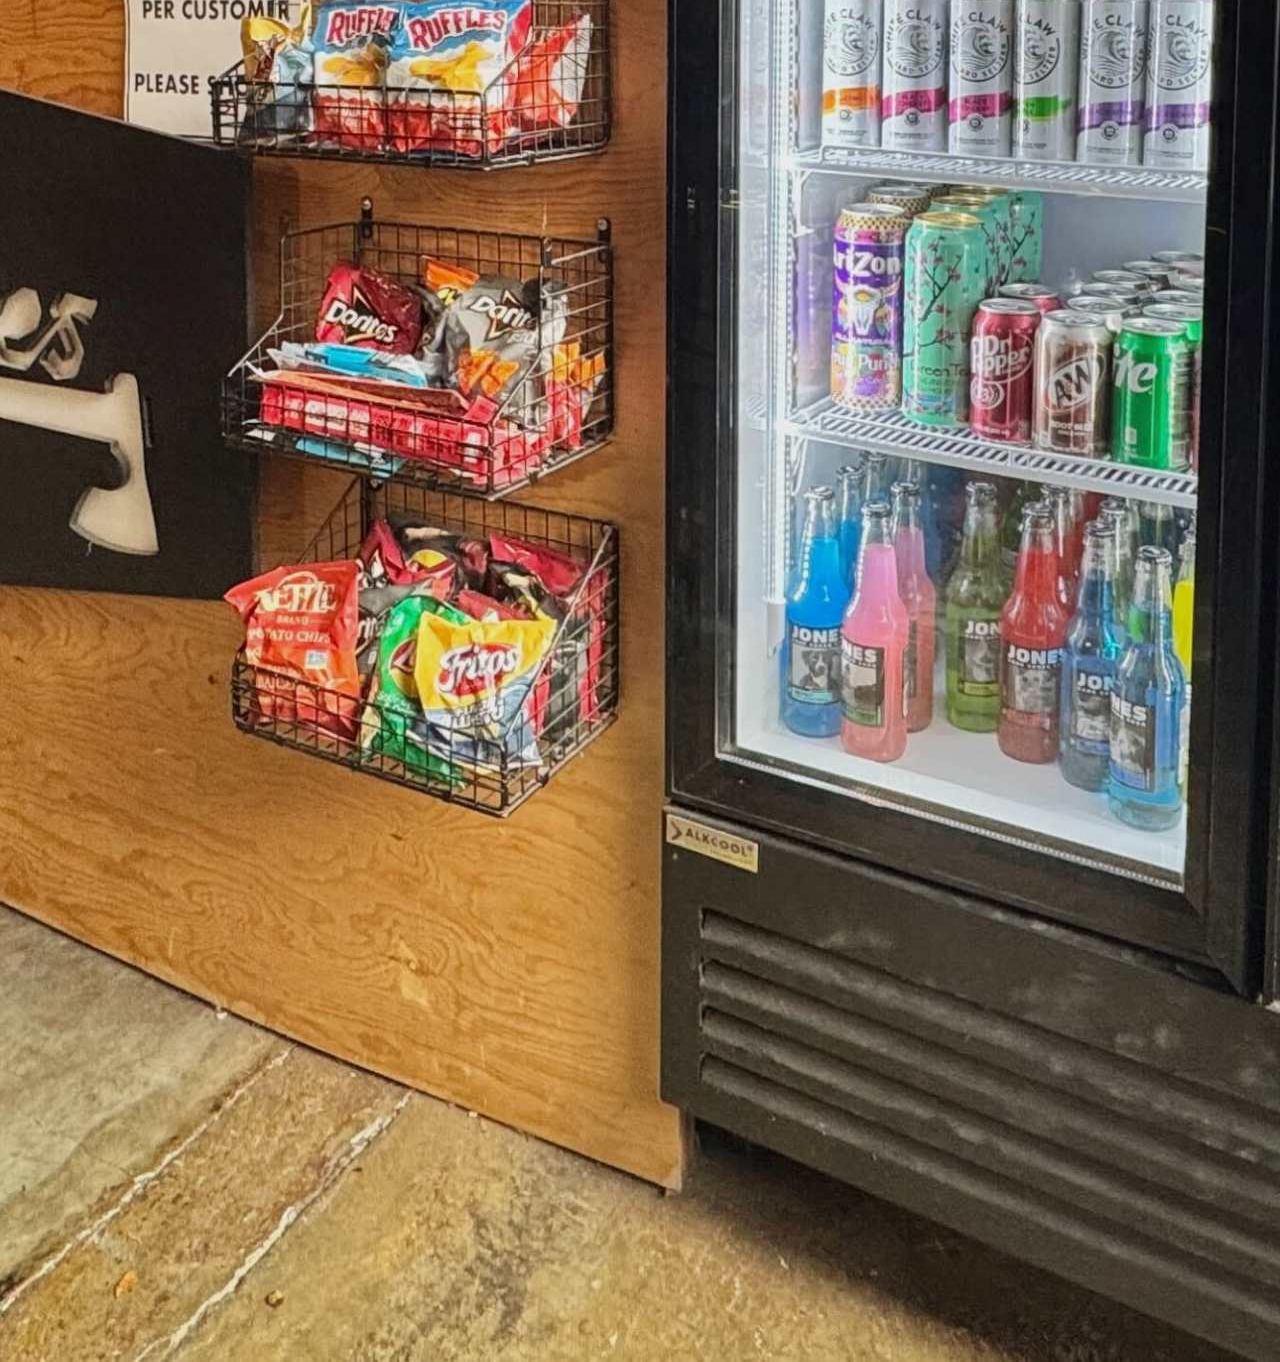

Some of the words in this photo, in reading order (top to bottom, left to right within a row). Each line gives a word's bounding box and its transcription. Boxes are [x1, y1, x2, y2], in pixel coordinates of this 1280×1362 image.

[142, 0, 175, 20] PER
[182, 0, 290, 22] CUSTOMER
[905, 9, 941, 31] CLAW
[406, 8, 509, 51] RUFFLES
[968, 12, 1007, 34] CLAW
[134, 73, 200, 94] PLEASE
[323, 299, 399, 343] Doritos
[981, 334, 1012, 357] Dr
[792, 625, 840, 644] JONE
[438, 643, 519, 694] Fritos
[685, 827, 749, 858] ALKCOOL
